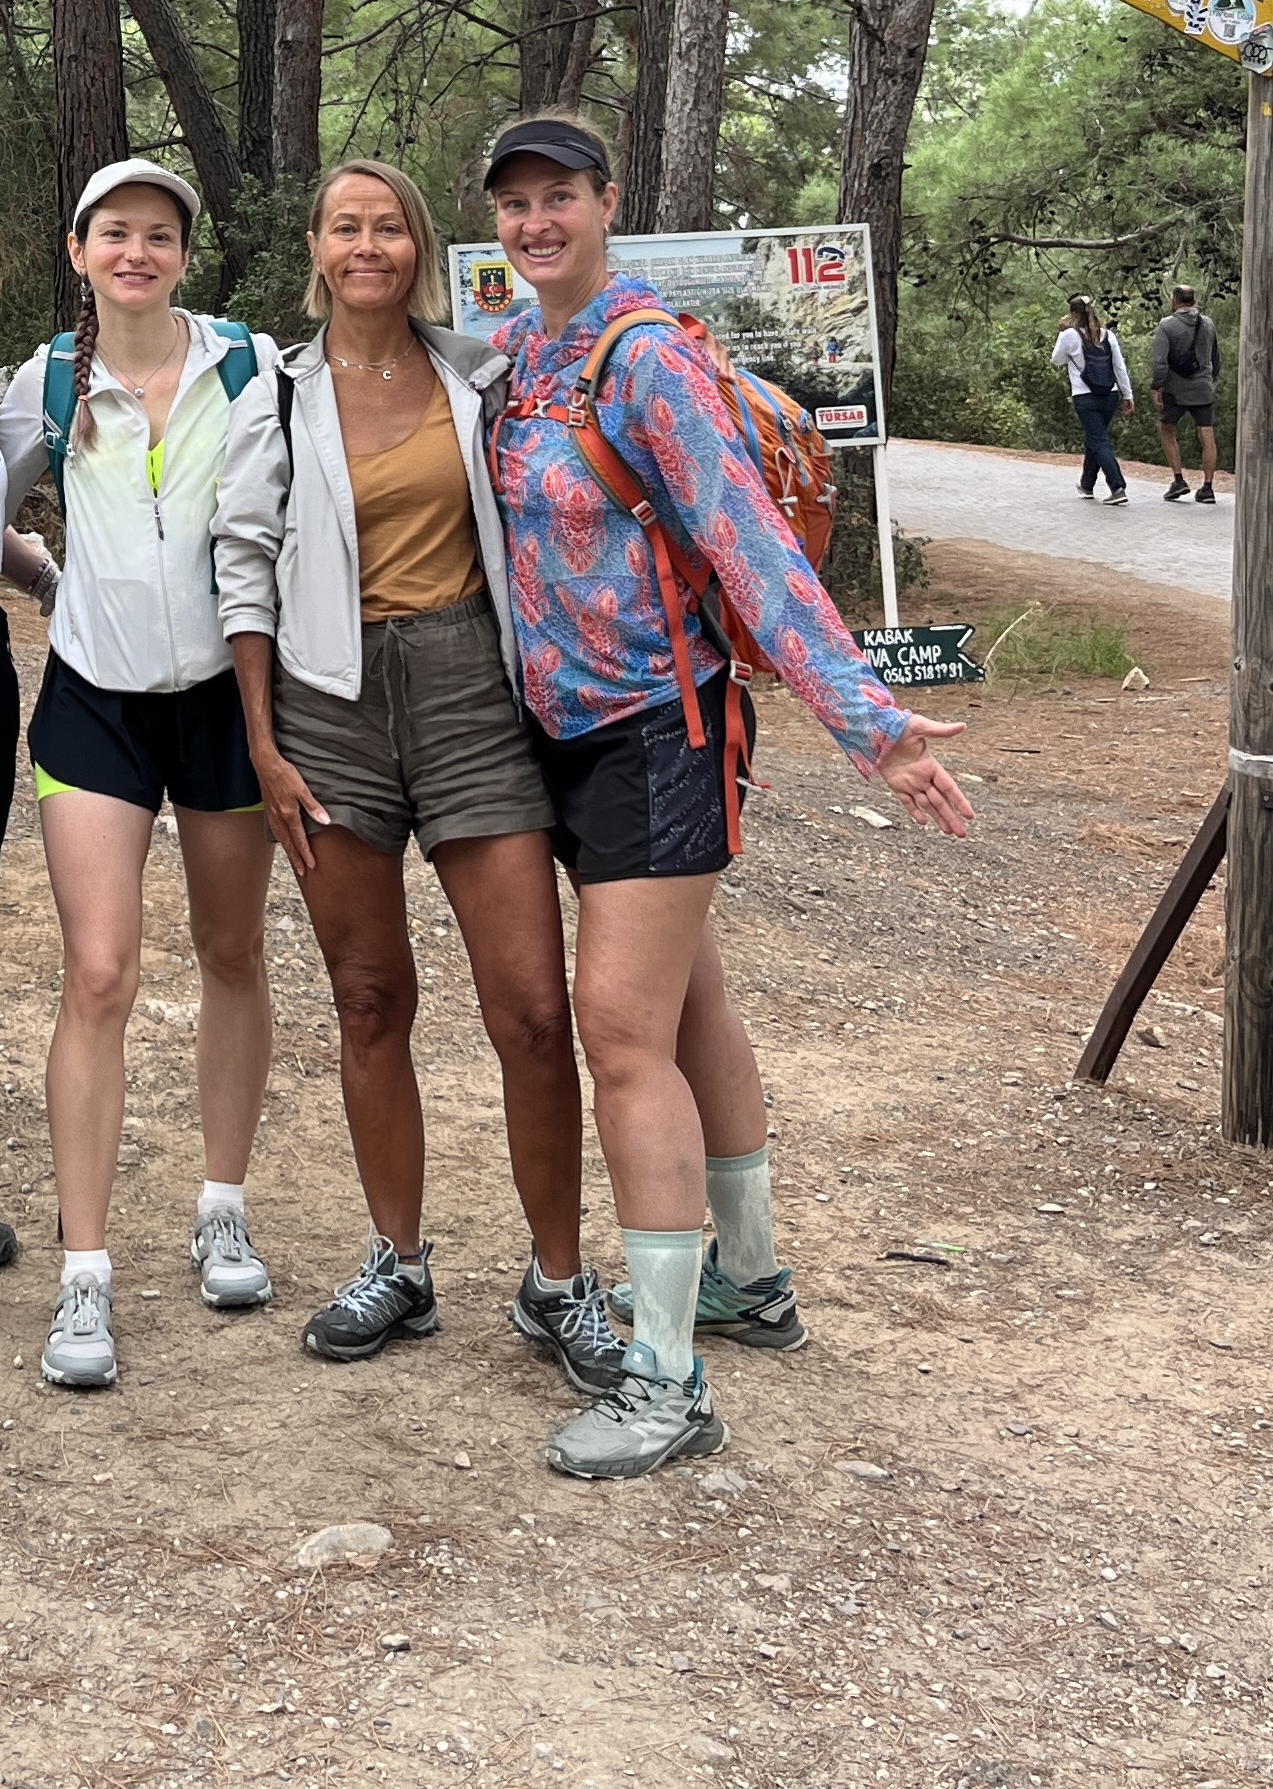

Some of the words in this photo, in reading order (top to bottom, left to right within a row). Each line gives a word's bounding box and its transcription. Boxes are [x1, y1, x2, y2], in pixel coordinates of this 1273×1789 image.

[787, 246, 847, 285] 112
[864, 628, 914, 647] KABAK
[897, 645, 942, 665] CAMP
